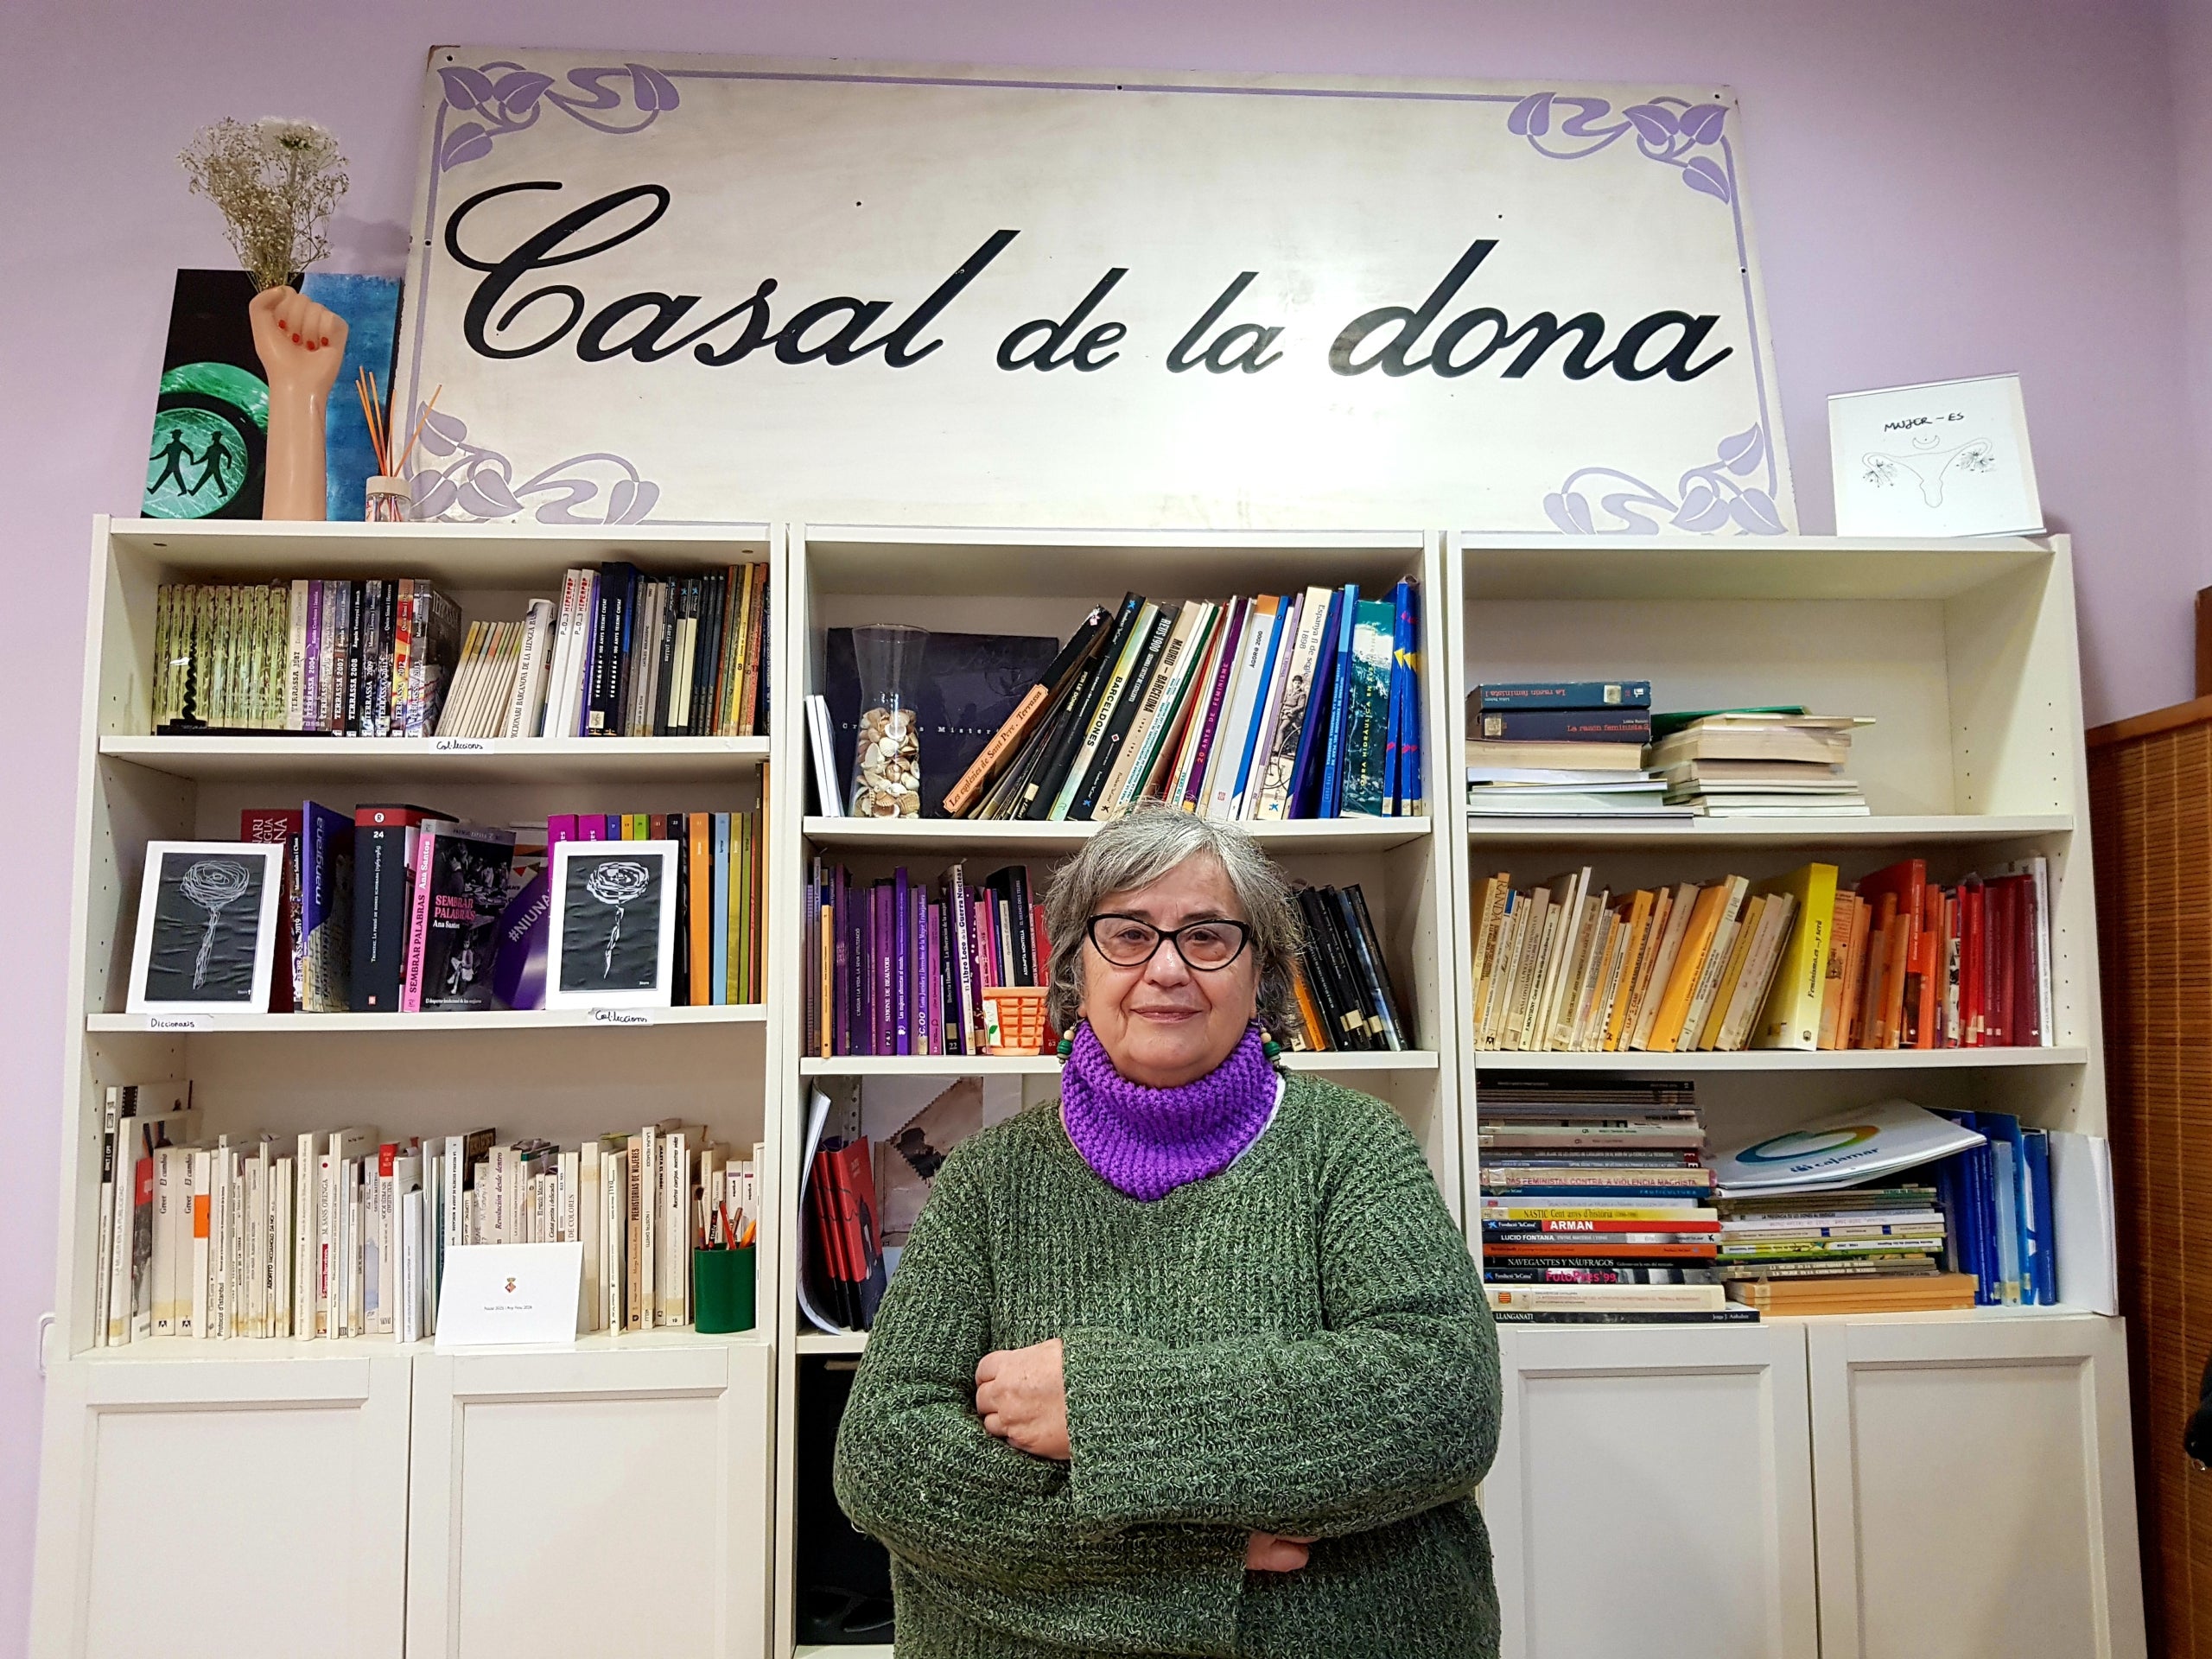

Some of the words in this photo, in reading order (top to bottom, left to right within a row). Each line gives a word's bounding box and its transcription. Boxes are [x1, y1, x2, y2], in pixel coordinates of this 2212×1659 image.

[444, 181, 1020, 371] Casal
[997, 266, 1128, 373] de
[1166, 270, 1283, 376] la
[1329, 238, 1733, 382] dona
[1884, 416, 1933, 432] MUJER
[1948, 413, 1964, 422] ES
[1156, 618, 1171, 636] REUS
[1313, 605, 1325, 636] Espanya
[1149, 634, 1164, 652] 1900
[1255, 630, 1264, 646] 2000
[1299, 630, 1309, 650] 1898
[1164, 638, 1184, 666] MADRID
[1307, 645, 1317, 656] de
[516, 672, 528, 705] BARCANOVA
[525, 627, 535, 651] LLENGUA
[1079, 671, 1088, 685] PER
[348, 678, 357, 720] TERRASSA
[396, 682, 404, 720] TERRASSA
[1066, 696, 1079, 712] DONNE
[1143, 674, 1168, 714] BARCELONA
[1365, 690, 1372, 704] EN
[1087, 675, 1123, 747] BARCELDONES
[1197, 751, 1205, 763] 20
[1201, 728, 1211, 749] ANYS
[1208, 711, 1216, 722] DE
[1212, 662, 1230, 707] FEMINISME
[980, 759, 990, 772] de
[1016, 690, 1042, 720] Terrassa
[1361, 705, 1370, 766] HIDRÀULICA
[315, 817, 325, 906] mangrana
[421, 841, 430, 870] Santos
[434, 906, 476, 920] PALABRAS
[435, 894, 474, 910] SEMBRAR
[413, 894, 425, 948] PALABRAS
[409, 949, 423, 994] SEMBRAR
[885, 988, 891, 996] DE
[1816, 1147, 1880, 1169] cajamar
[632, 1183, 640, 1221] PREHISTORIAS
[1524, 1210, 1548, 1218] NASTIC
[1550, 1210, 1565, 1218] Cent
[1550, 1220, 1593, 1230] ARMAN
[568, 1229, 574, 1237] DE
[1508, 1258, 1560, 1267] NAVEGANTES
[1568, 1257, 1614, 1267] NÁUFRAGOS
[1545, 1270, 1617, 1283] FotoPres'99
[216, 1282, 226, 1311] d'Istanbul
